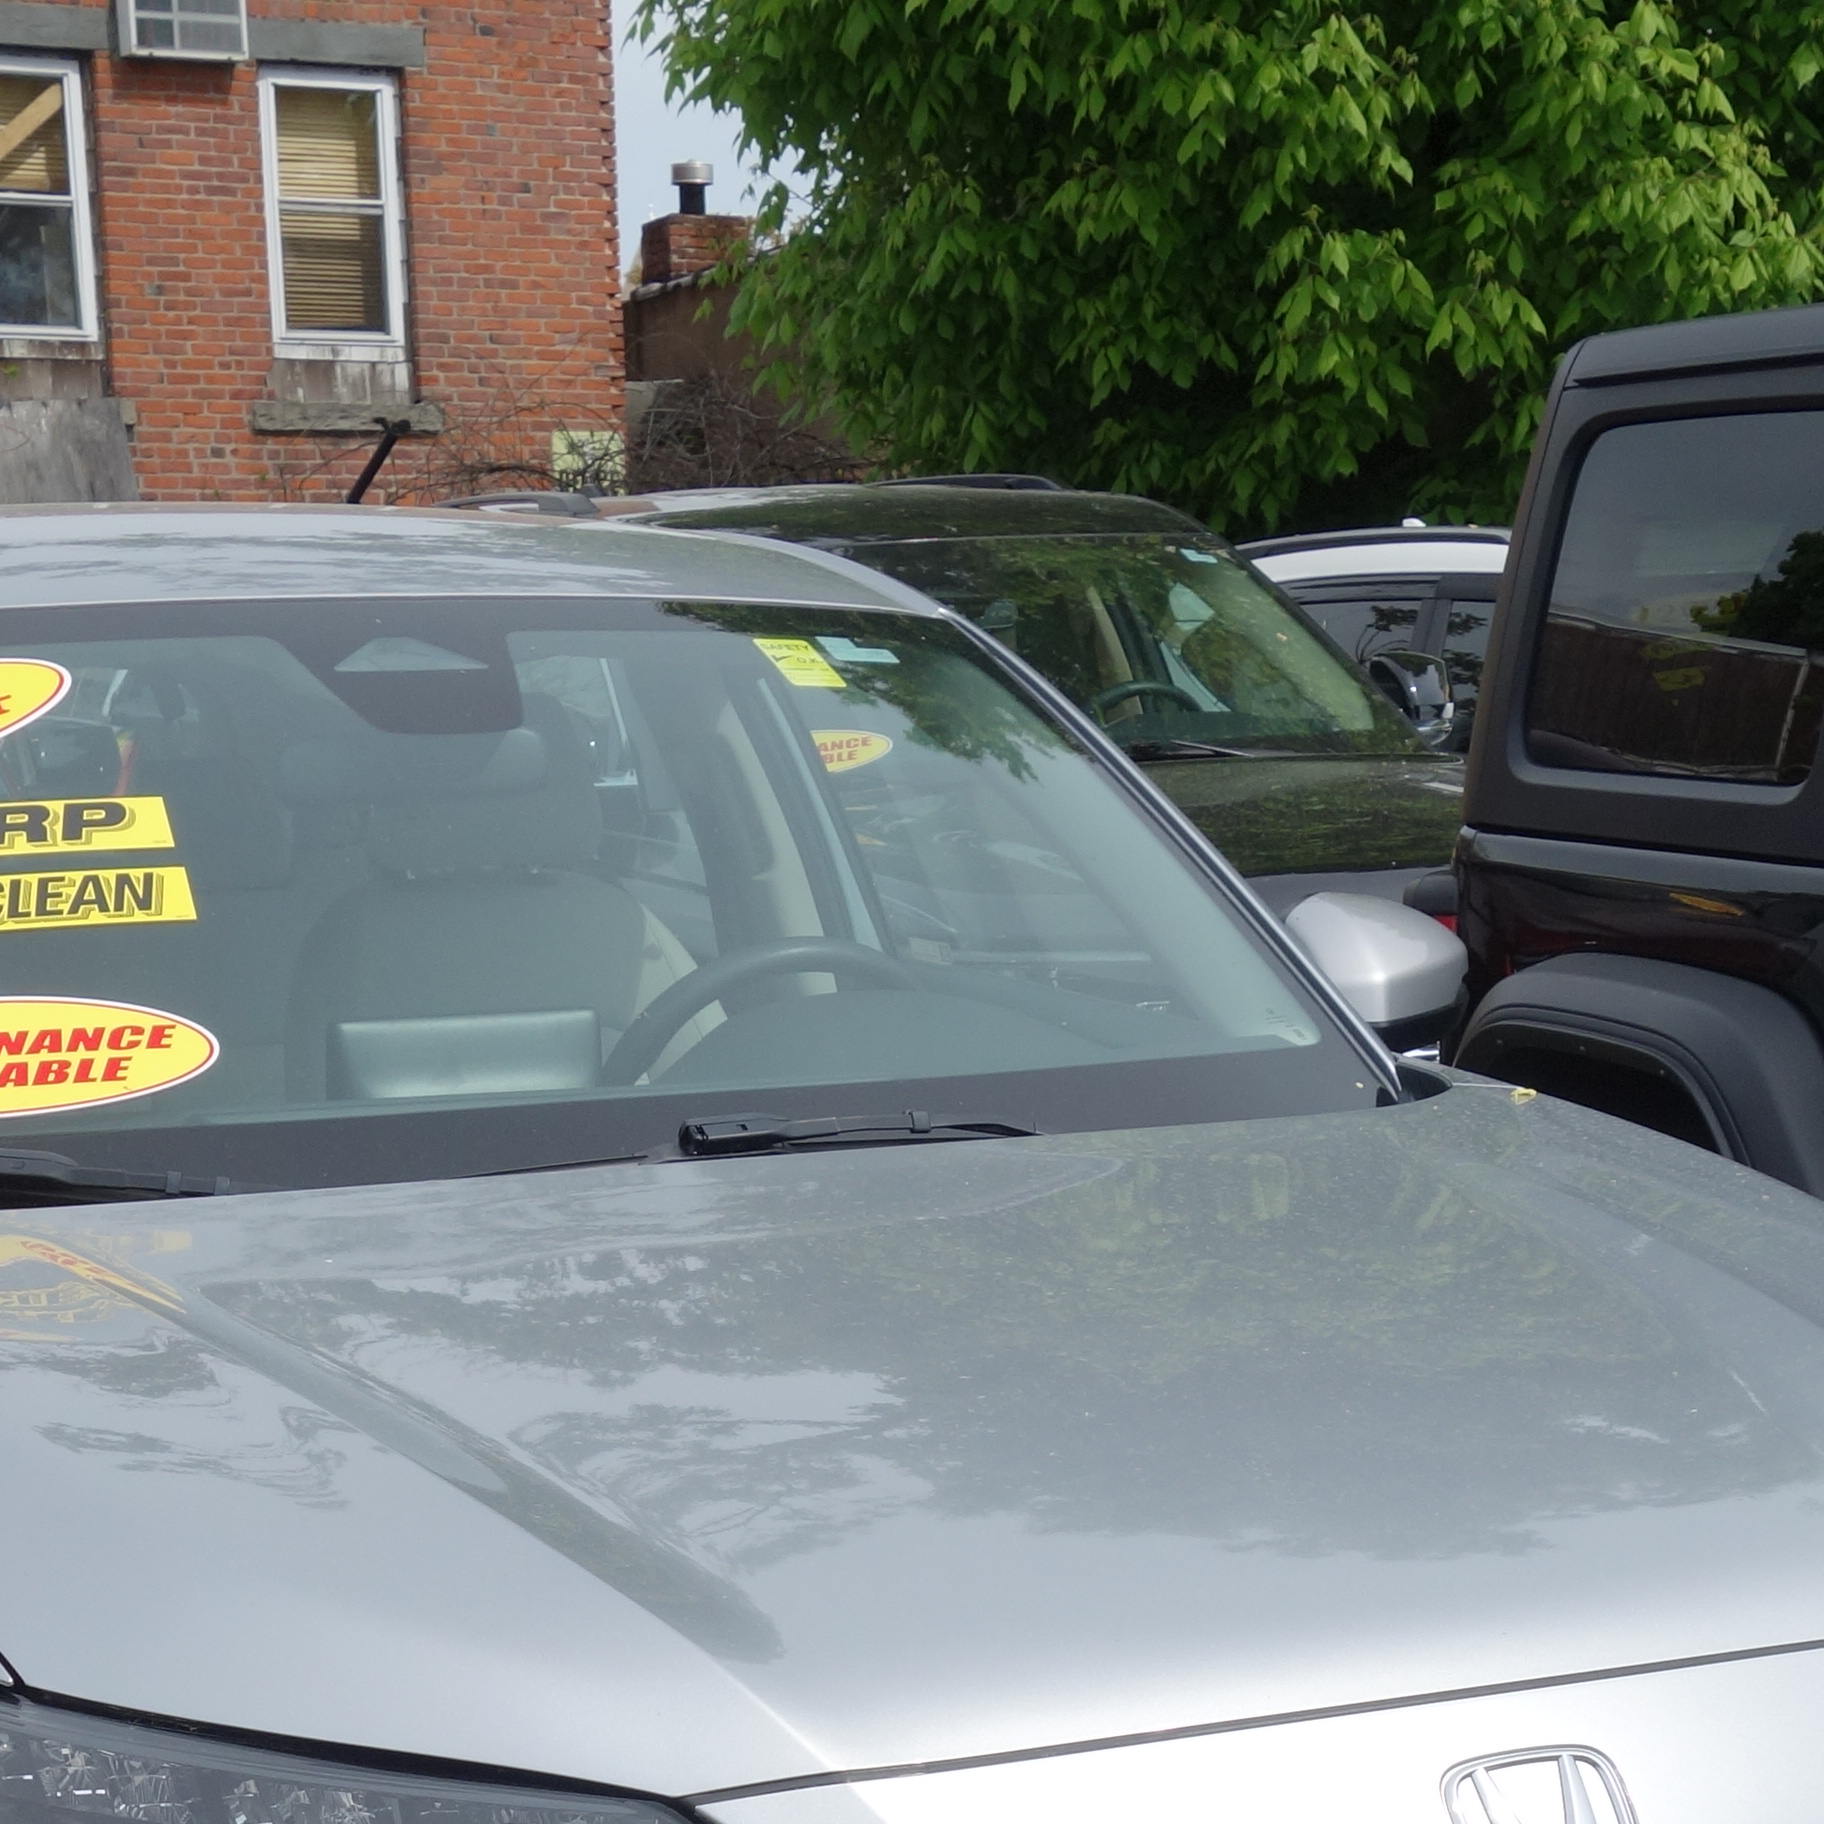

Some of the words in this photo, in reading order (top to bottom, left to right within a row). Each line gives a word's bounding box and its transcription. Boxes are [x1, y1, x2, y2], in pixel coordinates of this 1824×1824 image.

[759, 642, 810, 652] SAFETY
[817, 735, 873, 753] ANCE
[821, 749, 859, 764] BLE
